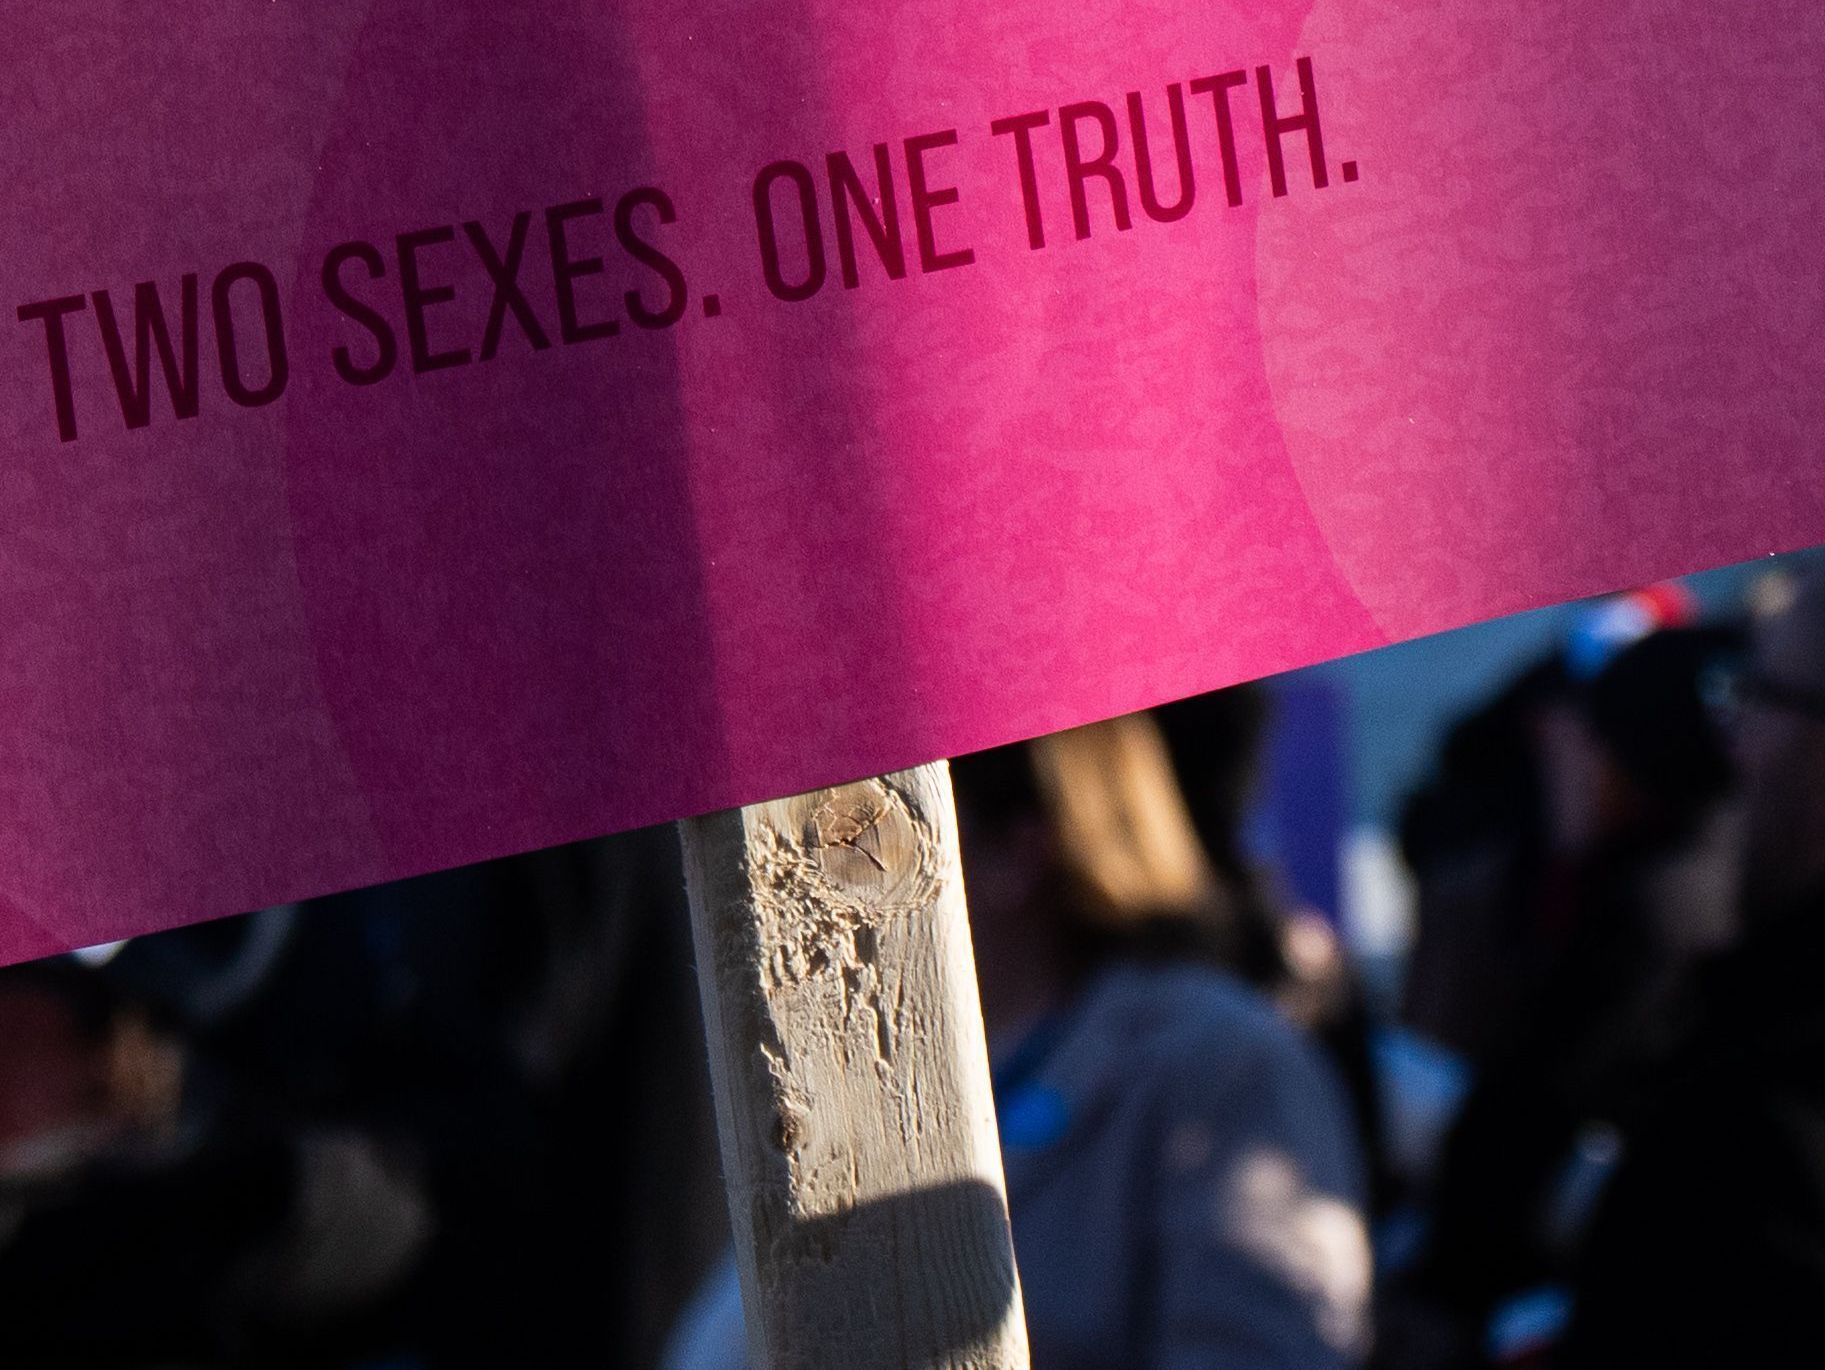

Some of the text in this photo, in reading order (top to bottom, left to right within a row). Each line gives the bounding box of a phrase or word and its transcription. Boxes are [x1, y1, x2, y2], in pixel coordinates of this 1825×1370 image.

[17, 56, 1360, 442] TWO SEXES. ONE TRUTH.
